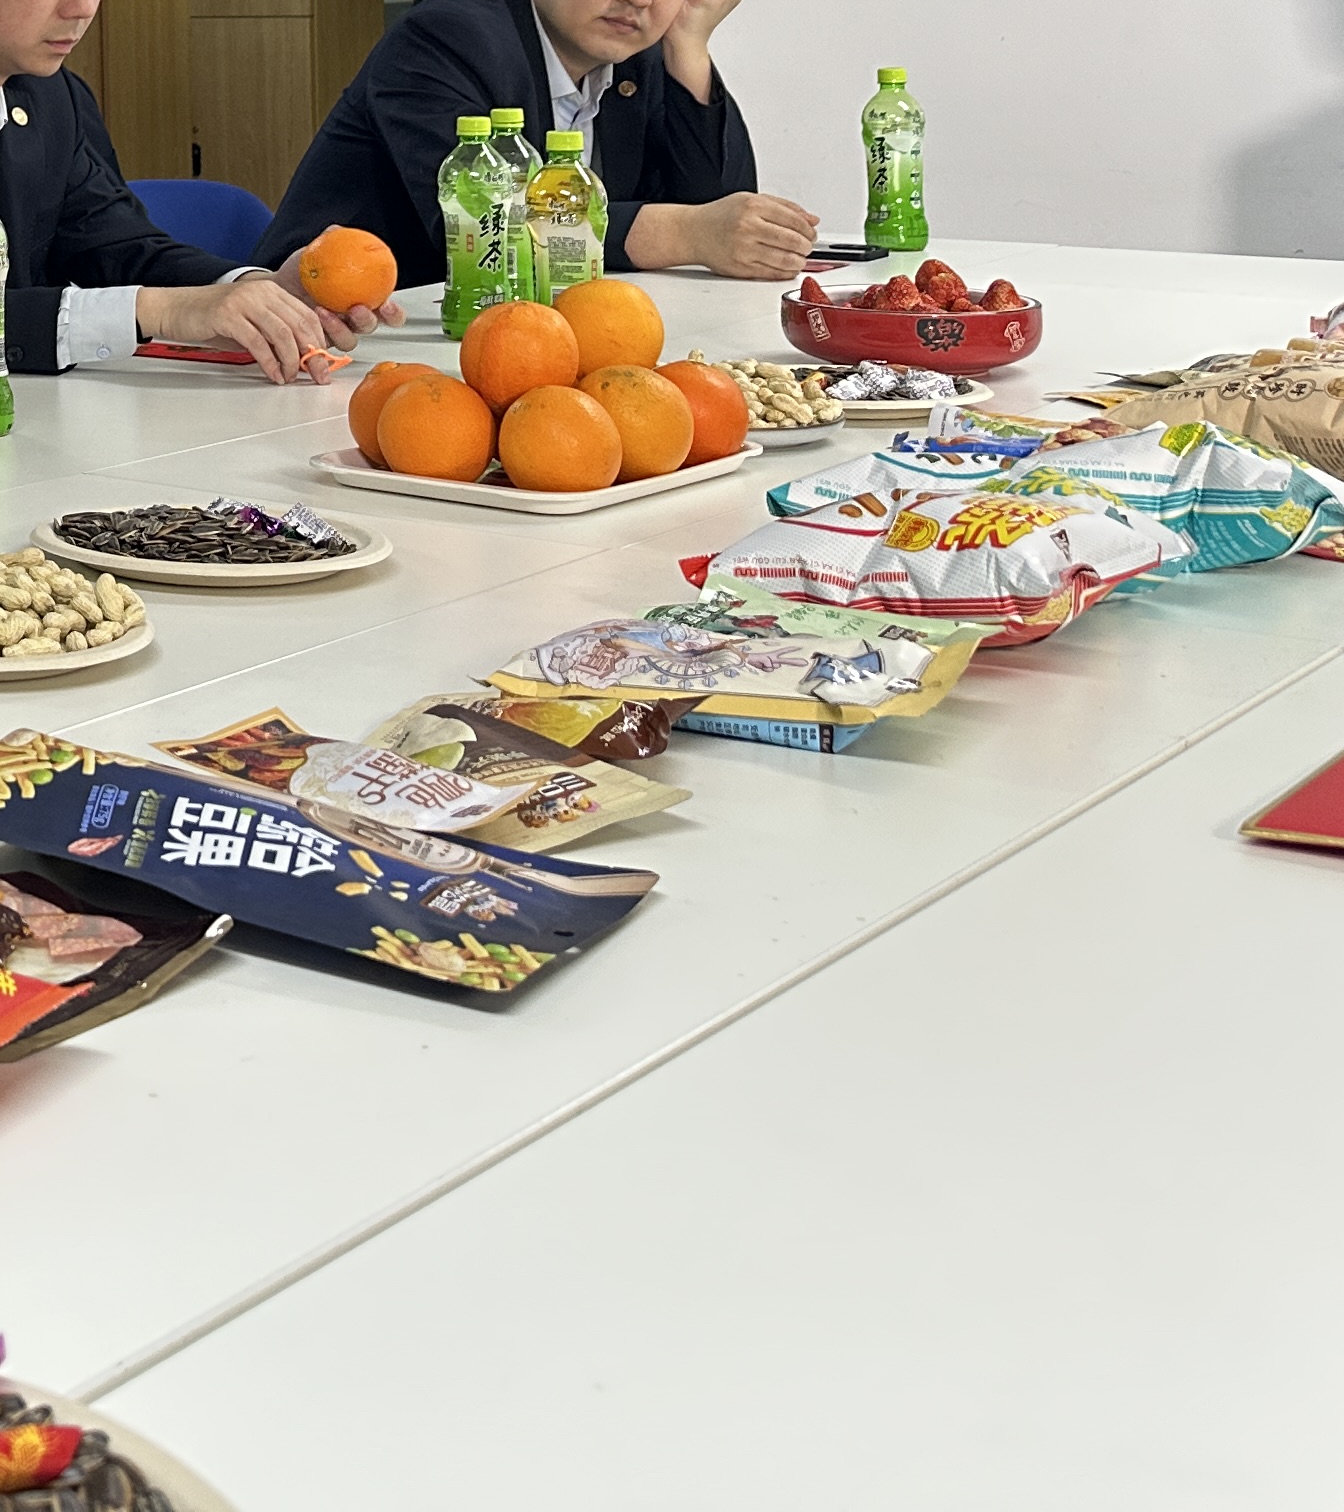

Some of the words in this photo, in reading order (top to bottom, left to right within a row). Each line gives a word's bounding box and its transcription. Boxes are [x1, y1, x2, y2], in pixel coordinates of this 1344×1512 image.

[870, 137, 891, 194] 绿茶
[478, 202, 506, 273] 绿茶
[160, 796, 252, 867] 豆果
